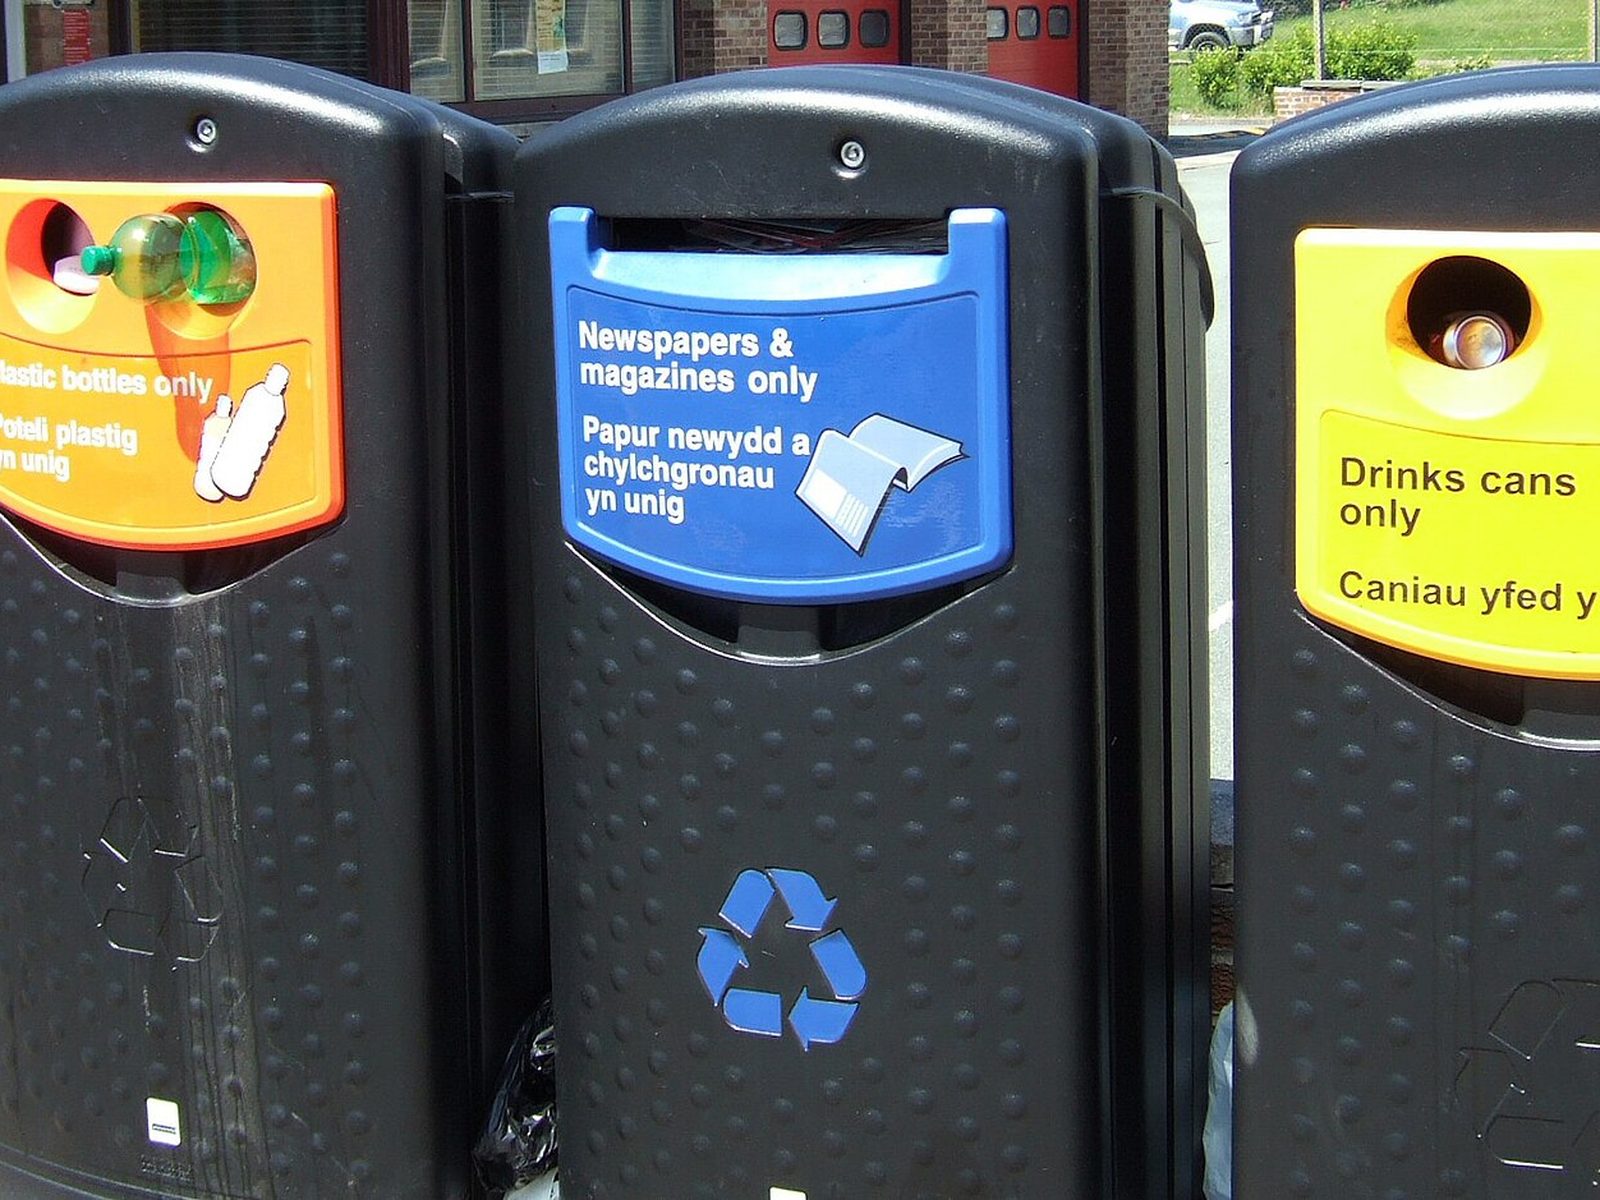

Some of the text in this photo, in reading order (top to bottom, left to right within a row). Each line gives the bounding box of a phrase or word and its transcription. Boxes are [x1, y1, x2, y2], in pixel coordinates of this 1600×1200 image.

[578, 321, 794, 360] Newspapers &
[62, 364, 147, 395] bottles
[154, 371, 213, 403] only
[580, 361, 818, 403] magazines only
[0, 411, 137, 455] oteli plastig
[583, 415, 811, 459] Papur newydd a
[21, 449, 70, 482] unig
[584, 451, 775, 490] chylchgronau
[1341, 457, 1577, 497] Drinks cans
[585, 487, 685, 524] yn unig
[1340, 498, 1421, 537] only
[1339, 570, 1466, 606] Caniau
[1480, 580, 1562, 616] yfed
